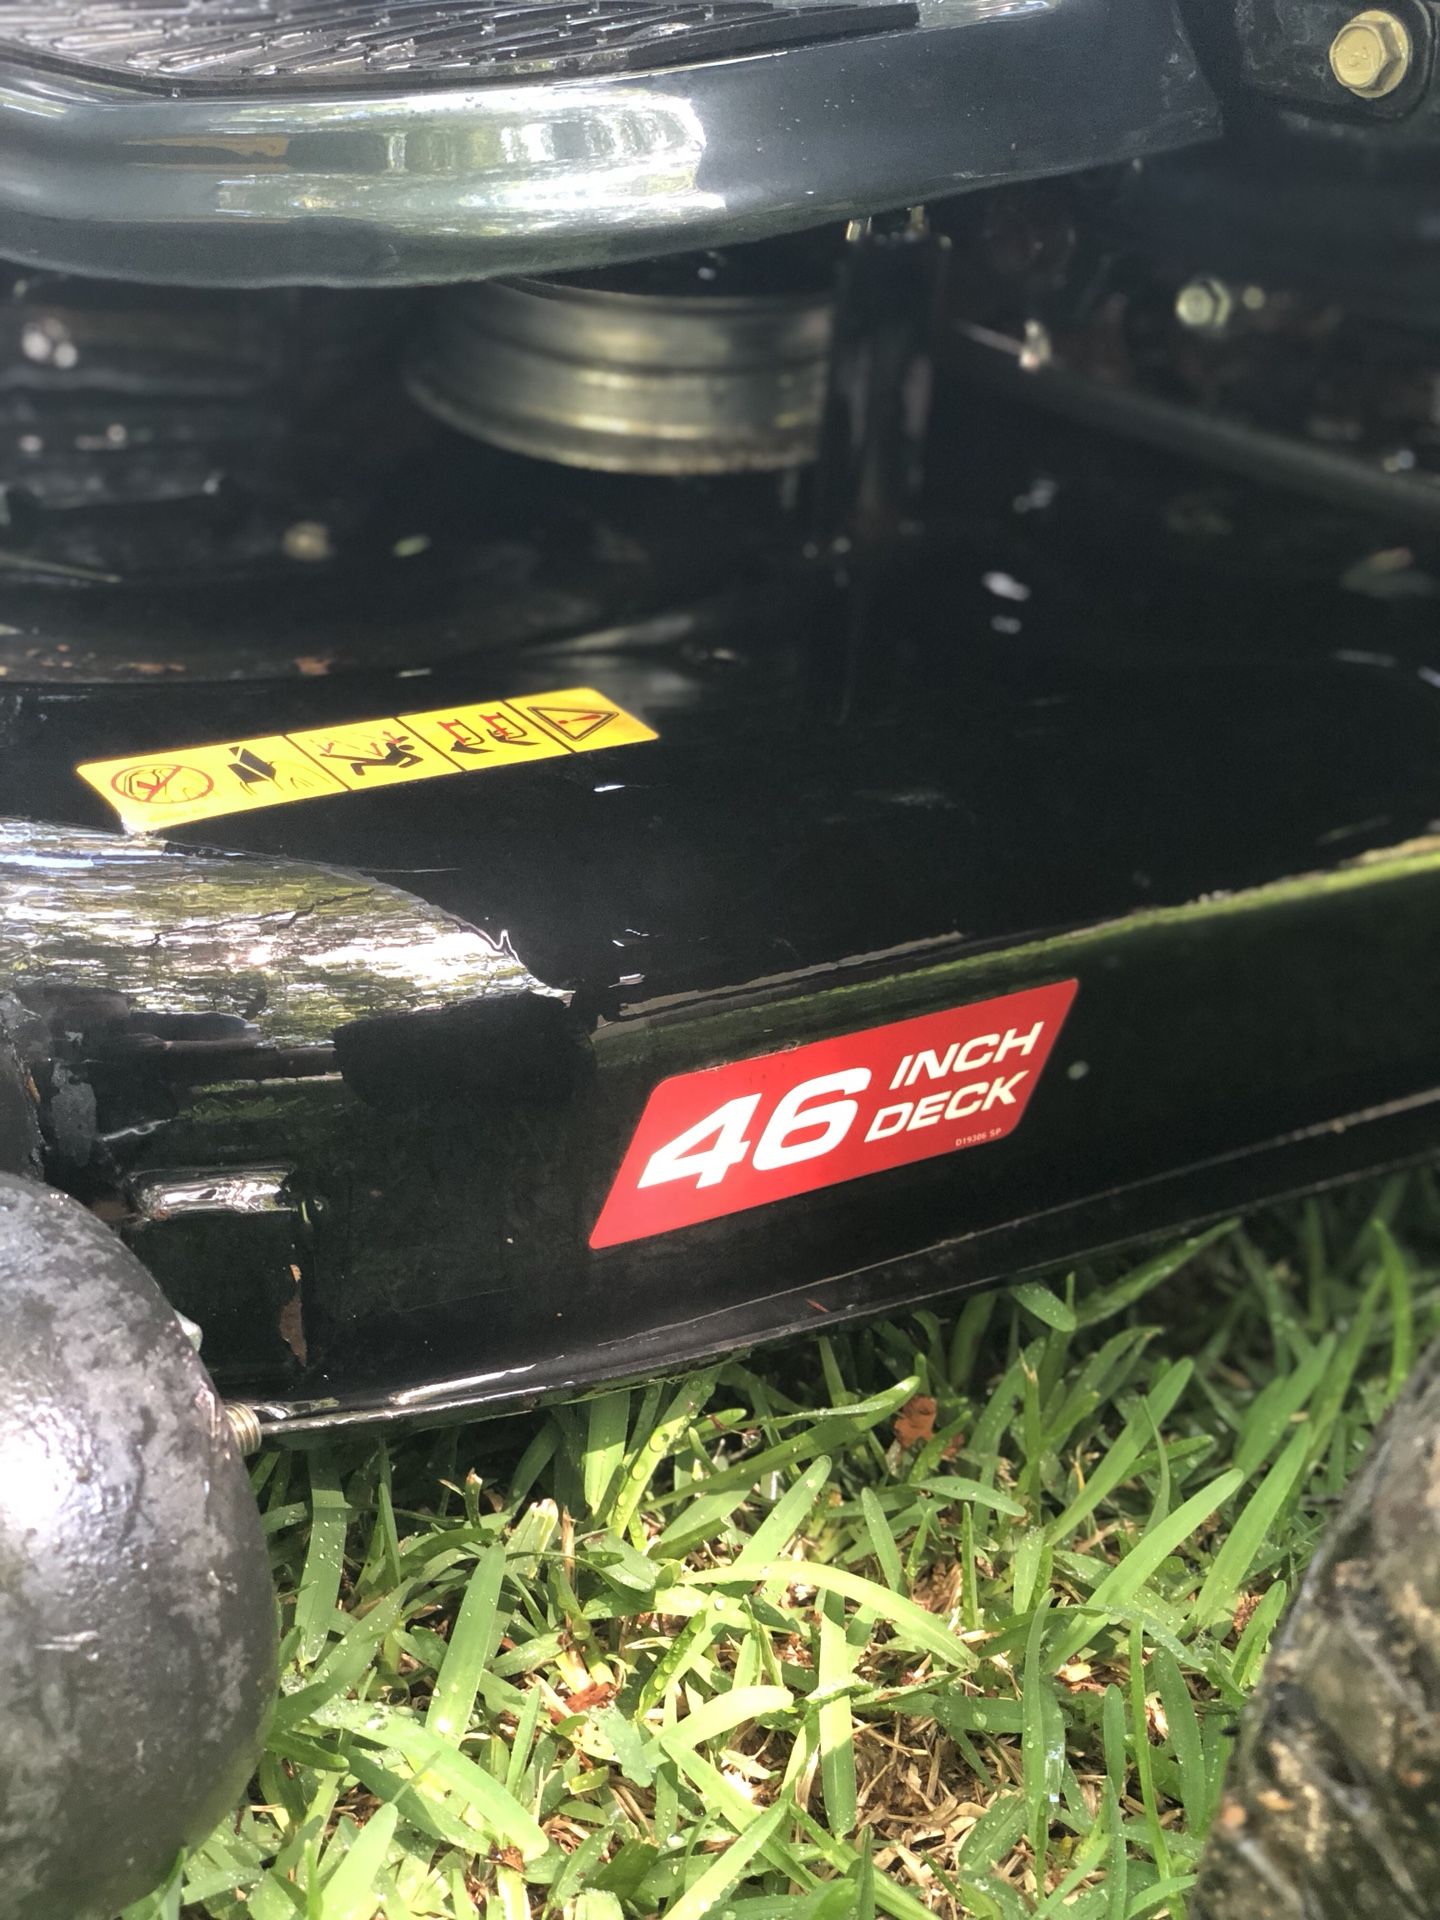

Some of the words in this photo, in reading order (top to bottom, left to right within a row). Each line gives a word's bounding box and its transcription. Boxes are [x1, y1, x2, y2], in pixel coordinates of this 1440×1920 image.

[889, 1021, 1044, 1090] INCH
[636, 1067, 872, 1189] 46
[864, 1071, 1028, 1143] DECK
[989, 1127, 1002, 1138] SP
